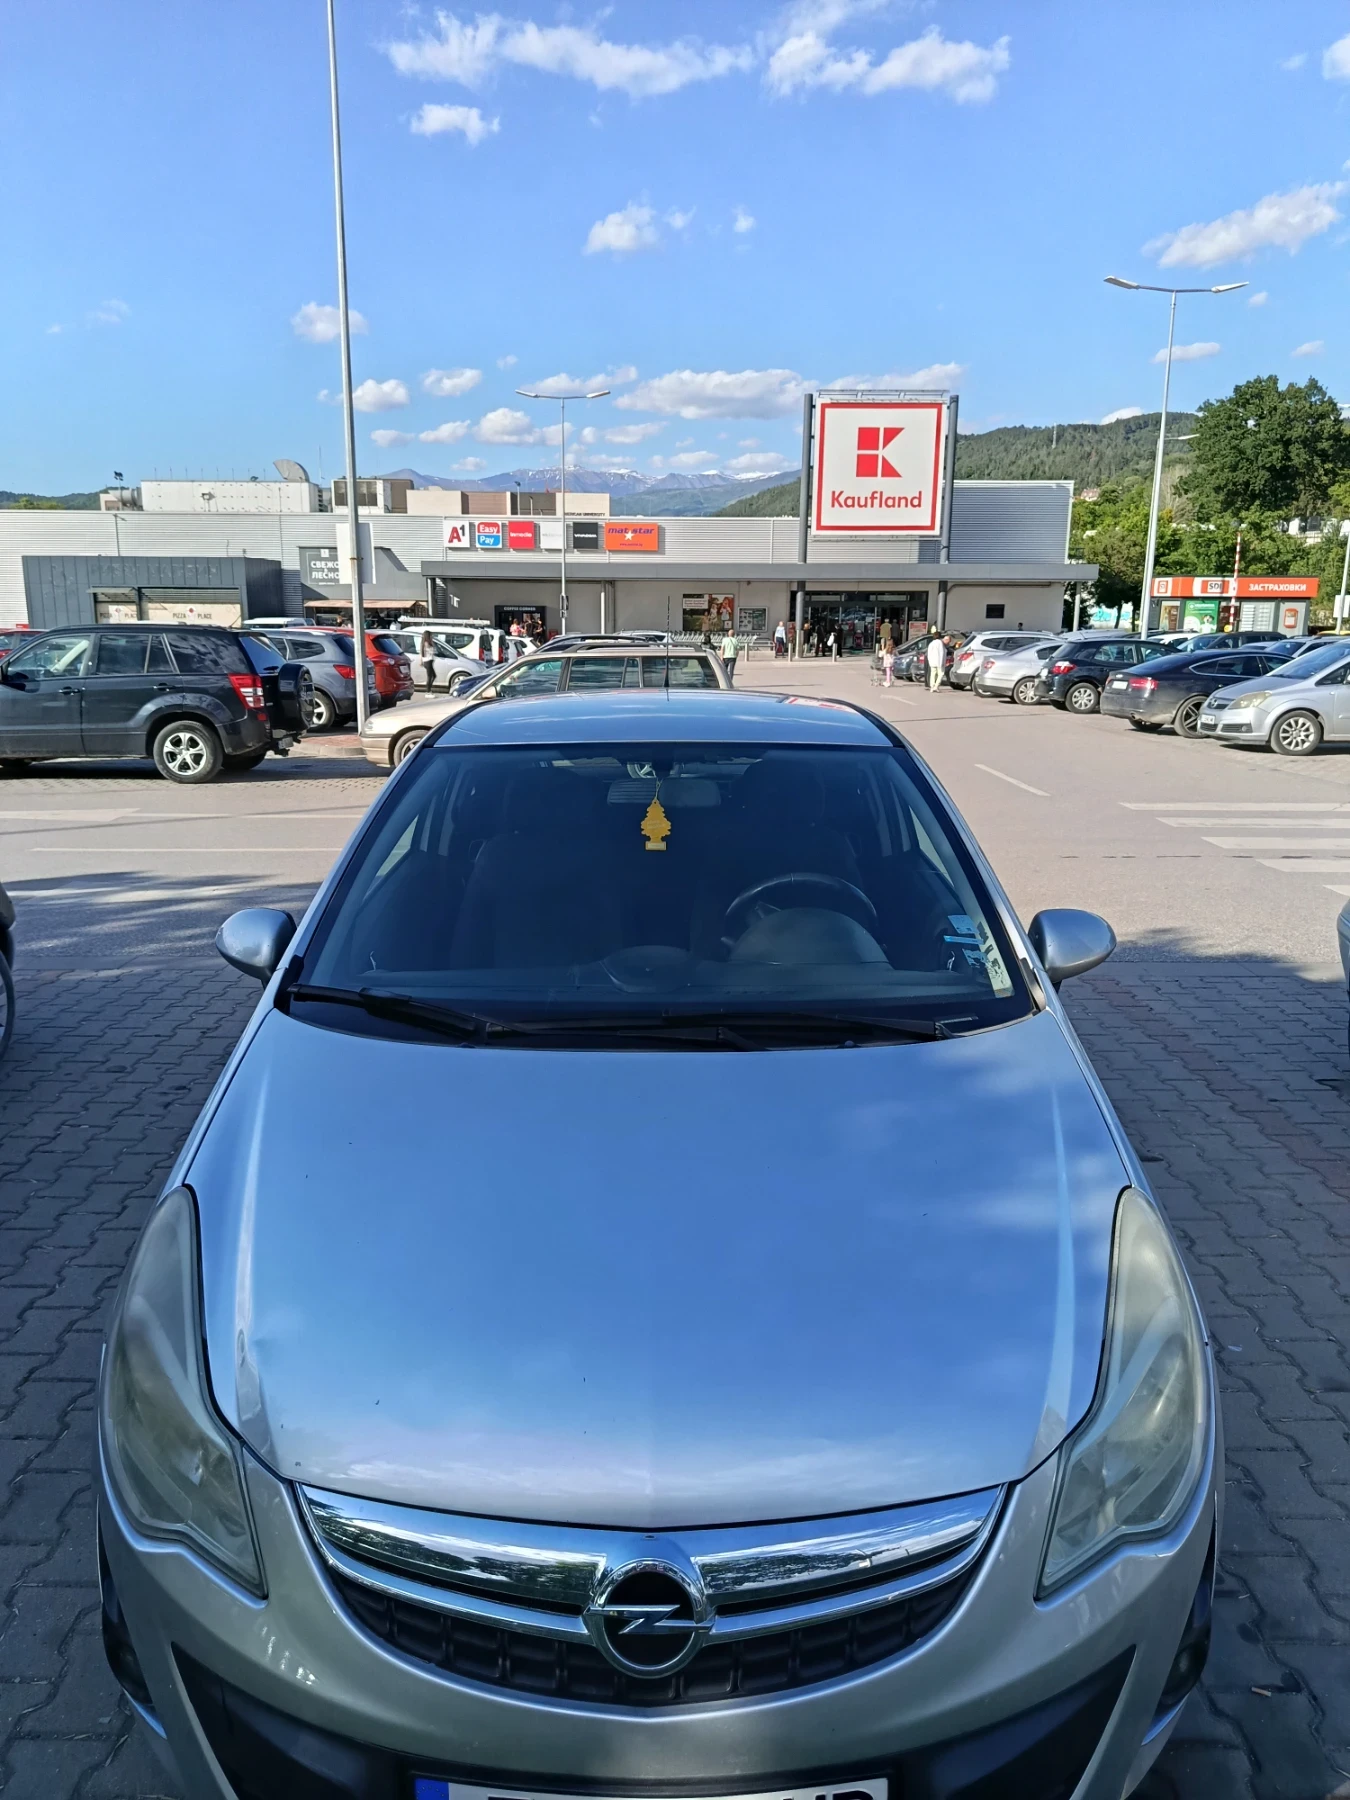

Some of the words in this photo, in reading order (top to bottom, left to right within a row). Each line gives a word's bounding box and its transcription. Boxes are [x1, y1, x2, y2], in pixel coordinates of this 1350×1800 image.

[830, 490, 922, 508] Kaufland
[448, 524, 465, 543] A1
[480, 524, 498, 534] Easy
[480, 536, 494, 545] Pay
[310, 560, 339, 569] СВЕЖО
[312, 571, 340, 579] ЛЕСНО
[1248, 583, 1307, 592] ЗАСТРАХОВКИ
